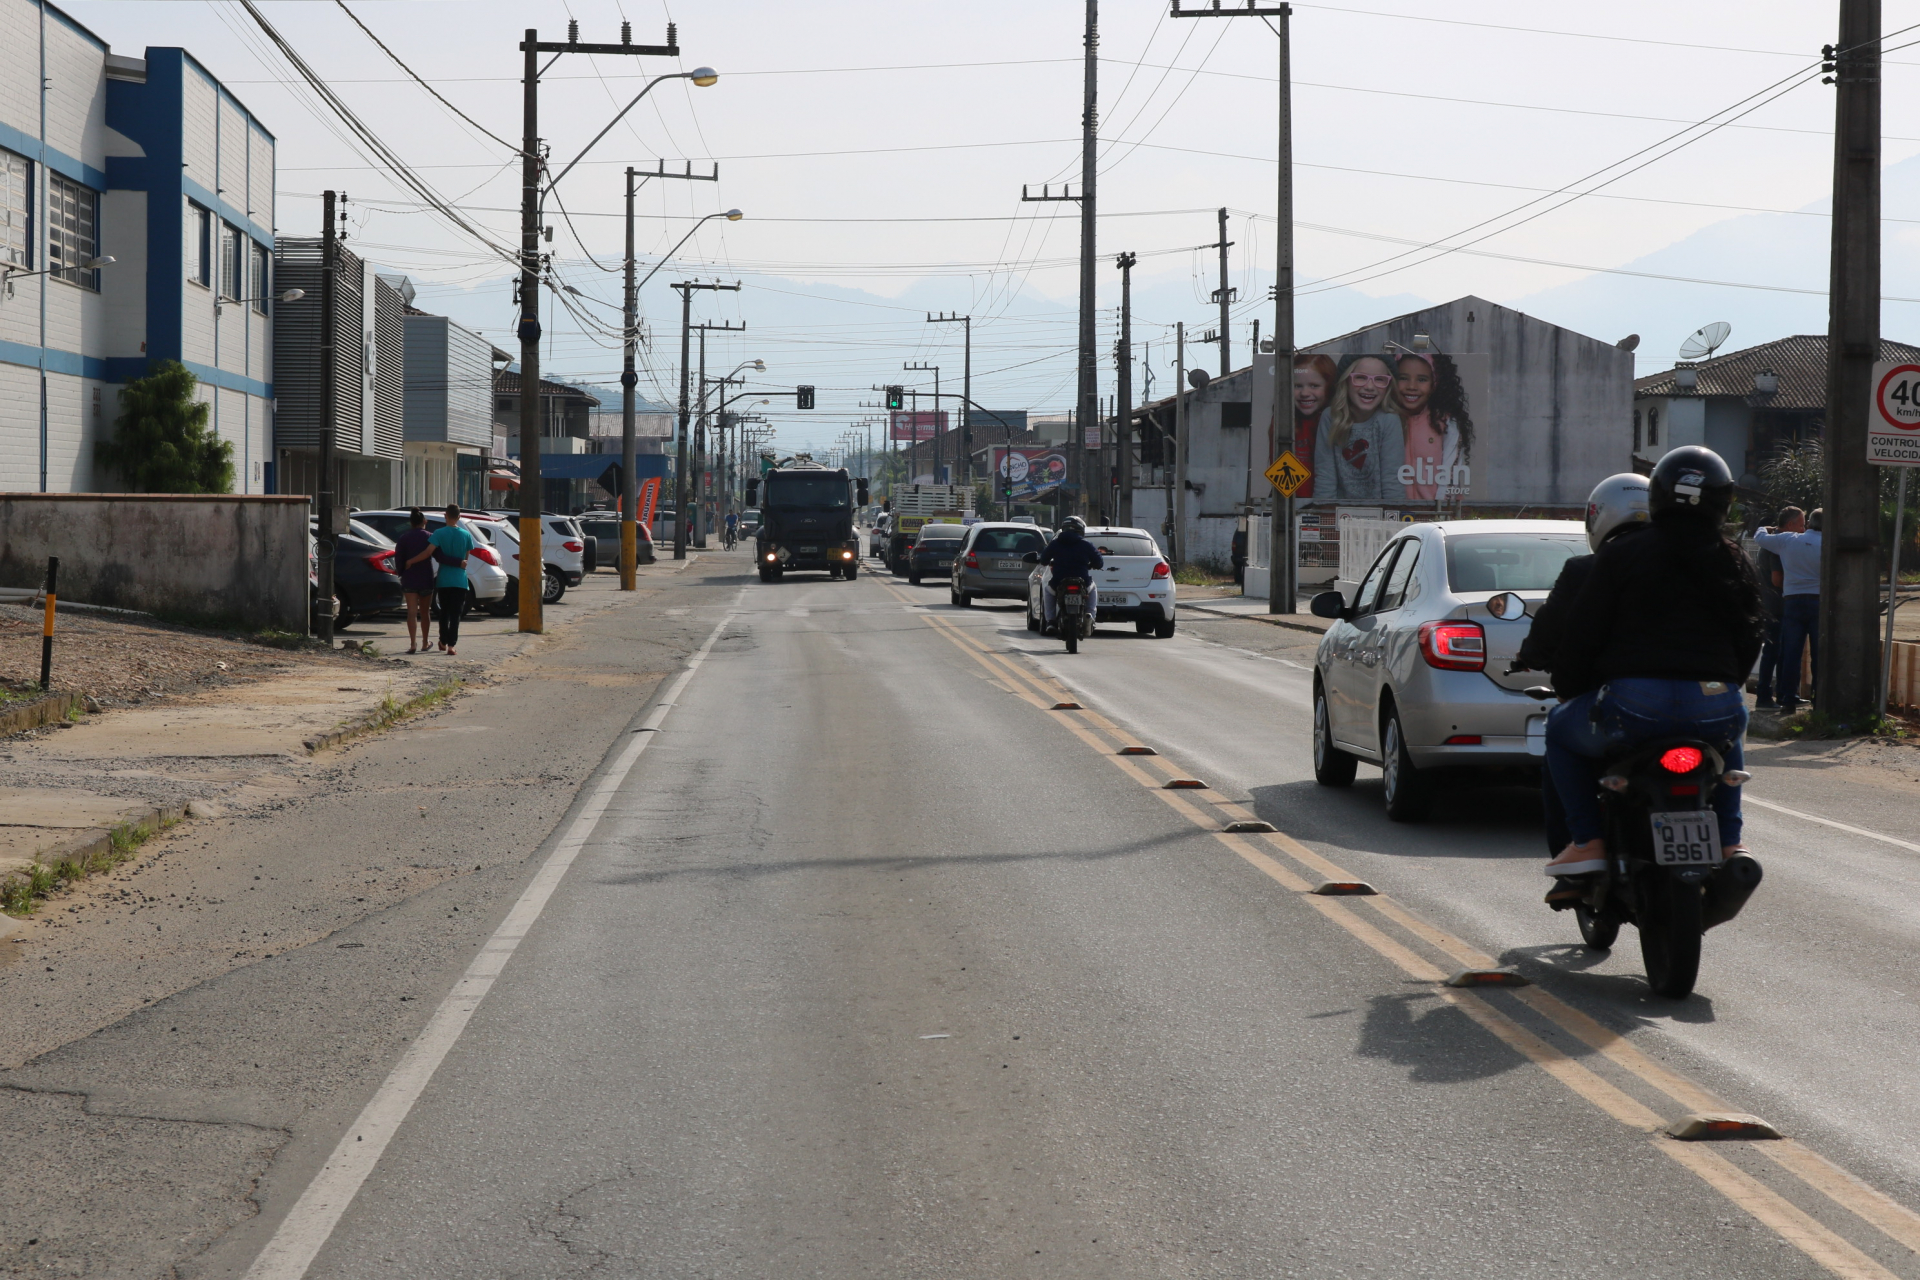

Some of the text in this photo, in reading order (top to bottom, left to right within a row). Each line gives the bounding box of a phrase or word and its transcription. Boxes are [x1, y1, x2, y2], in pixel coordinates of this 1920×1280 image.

[1891, 380, 1920, 407] 40
[1896, 406, 1920, 417] km/h
[1874, 448, 1920, 459] VELOCID
[1002, 461, 1027, 472] RNCHO
[1398, 456, 1470, 486] elian
[1662, 824, 1710, 842] QIU
[1664, 842, 1713, 862] 5961
